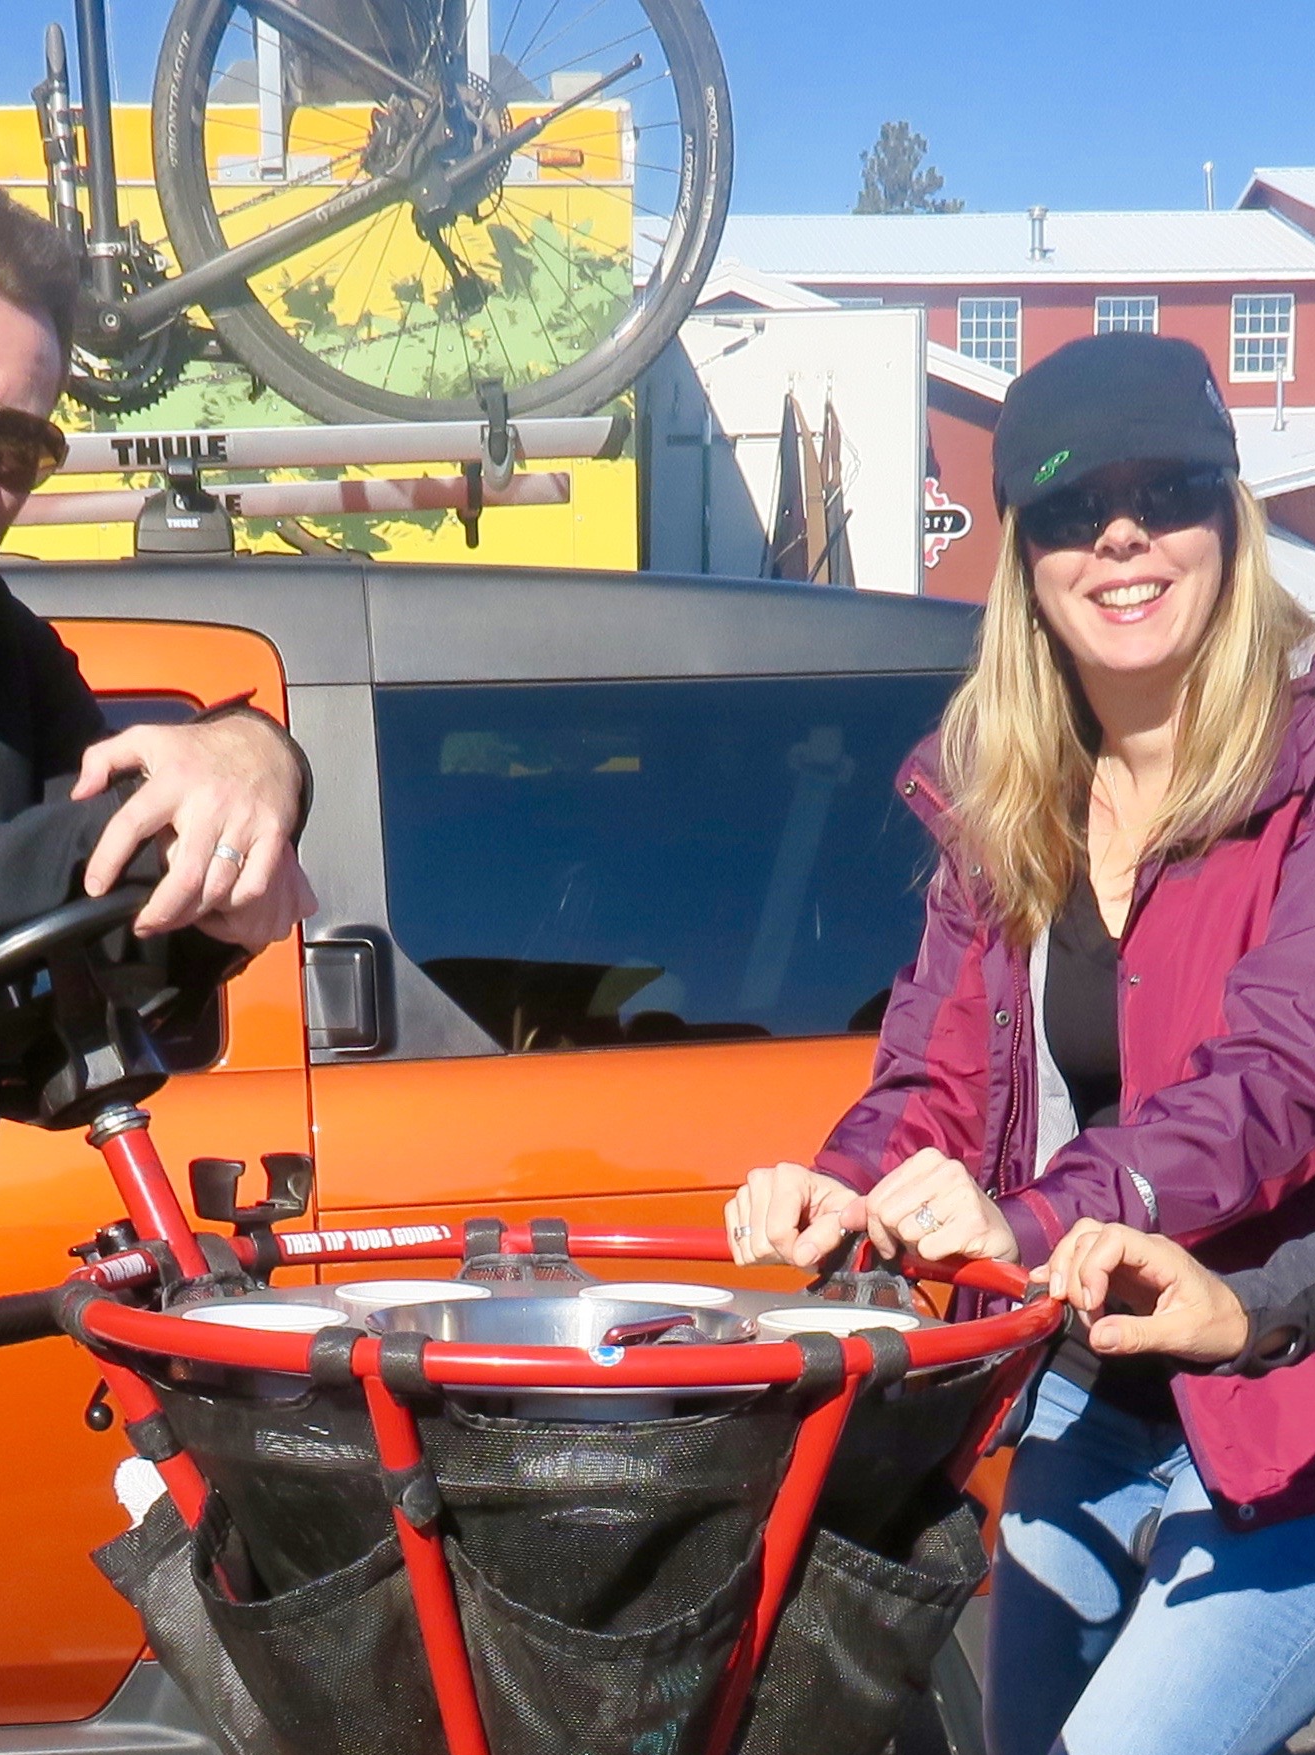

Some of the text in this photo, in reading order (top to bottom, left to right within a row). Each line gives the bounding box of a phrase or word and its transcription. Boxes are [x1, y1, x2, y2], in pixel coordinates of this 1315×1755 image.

[111, 435, 228, 467] THULE
[166, 518, 200, 529] THULE
[280, 1233, 322, 1255] THEN
[319, 1230, 347, 1252] TIP
[345, 1228, 393, 1251] YOUR
